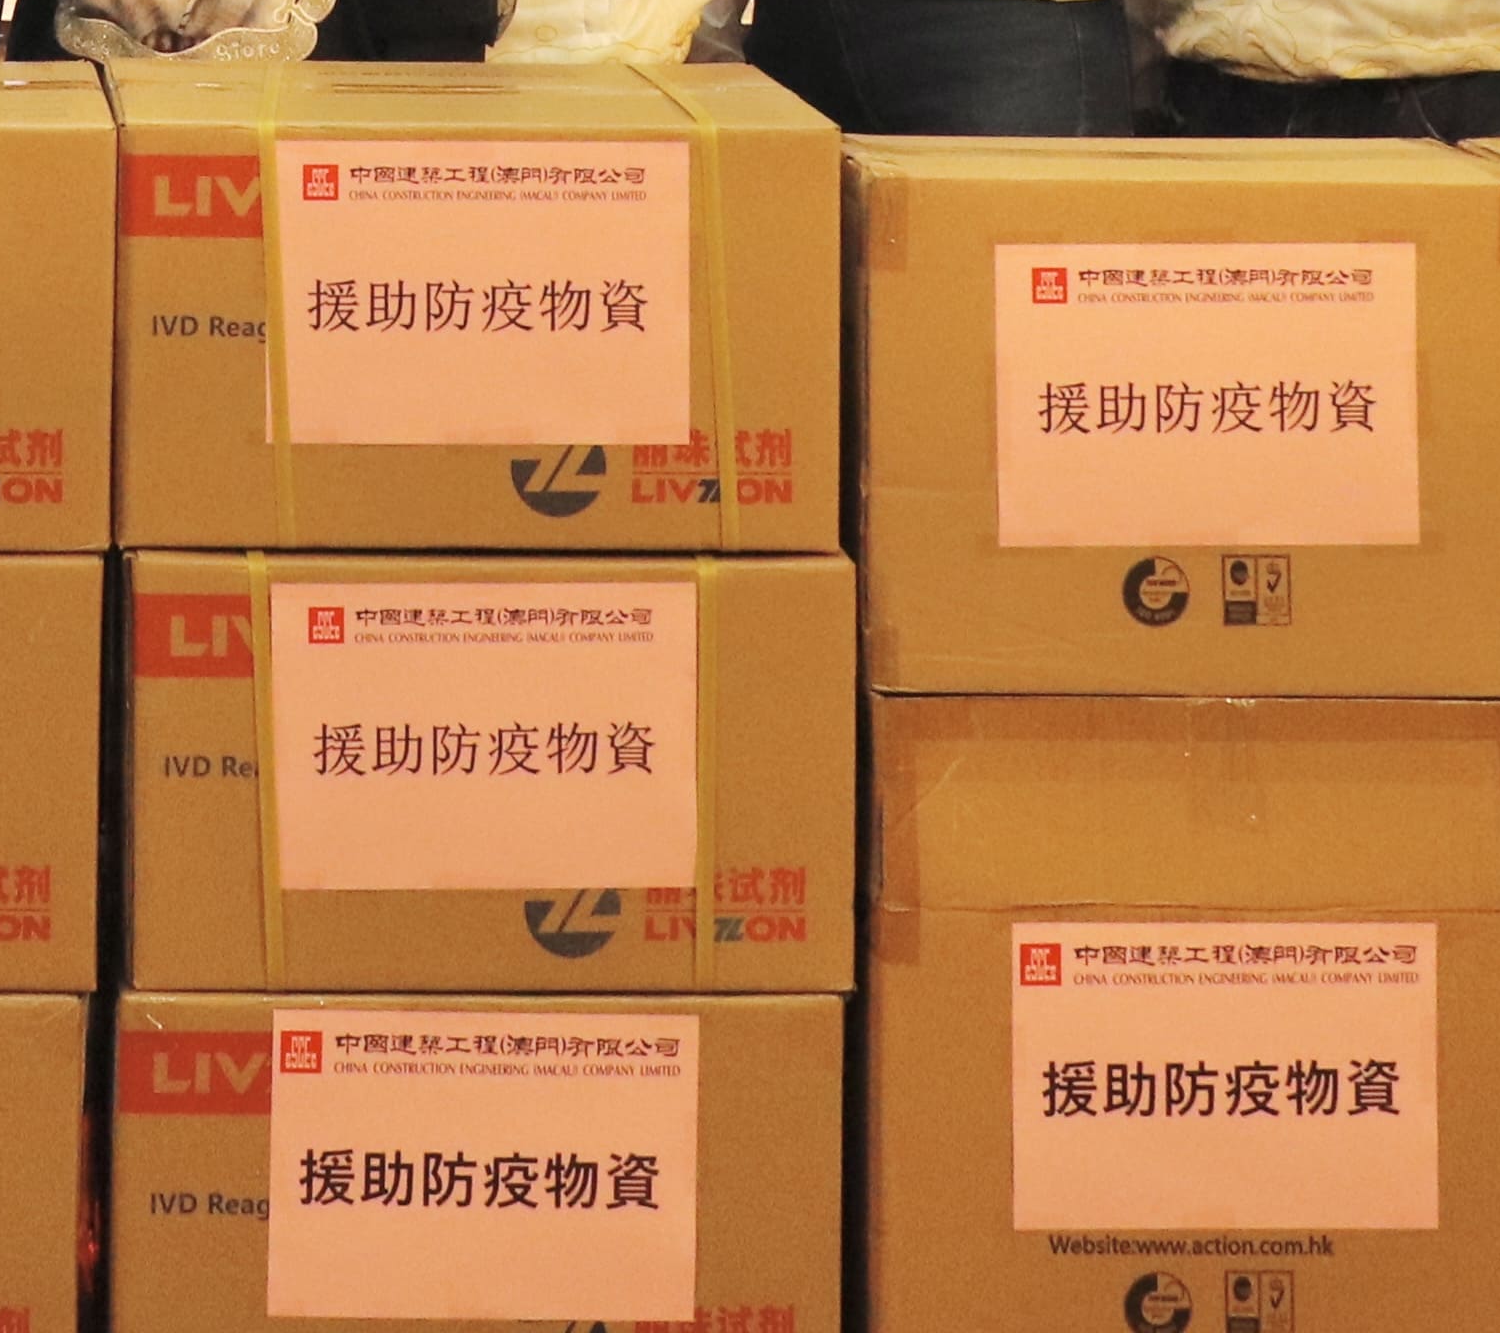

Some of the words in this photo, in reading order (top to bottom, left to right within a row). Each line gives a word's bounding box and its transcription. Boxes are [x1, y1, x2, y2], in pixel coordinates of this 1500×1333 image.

[152, 314, 199, 337] IVD
[307, 278, 648, 333] 援助防疫物資
[1038, 379, 1377, 435] 援助防疫物資
[163, 755, 211, 778] IVD
[313, 721, 656, 777] 援助防疫物資
[1042, 1058, 1400, 1118] 援助防疫物資
[150, 1193, 197, 1215] IVD
[298, 1148, 660, 1211] 援助防疫物資
[1048, 1234, 1334, 1257] Website:www.action.com.hk
